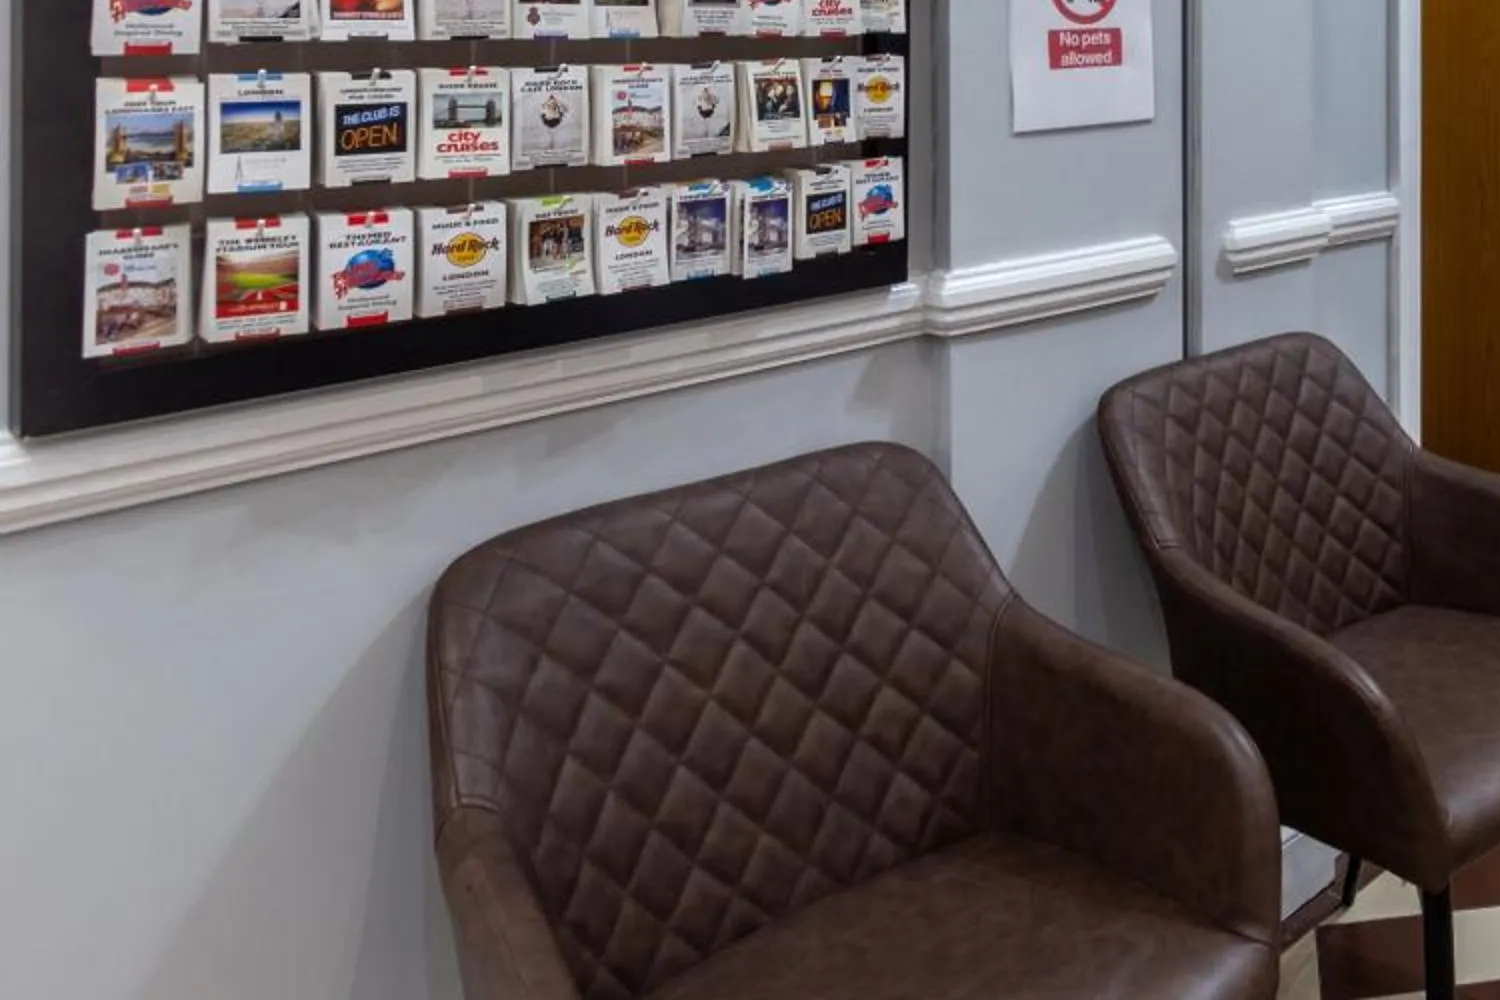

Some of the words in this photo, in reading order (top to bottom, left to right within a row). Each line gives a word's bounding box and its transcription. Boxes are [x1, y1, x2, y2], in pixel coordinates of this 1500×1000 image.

[1059, 31, 1079, 46] No
[1081, 31, 1111, 50] pets
[1061, 50, 1113, 67] allowed
[343, 114, 360, 125] THE
[388, 106, 400, 117] IS
[341, 123, 399, 150] OPEN
[448, 130, 480, 142] city
[436, 139, 499, 153] cruises
[432, 240, 465, 256] Hard
[467, 237, 500, 252] Rock
